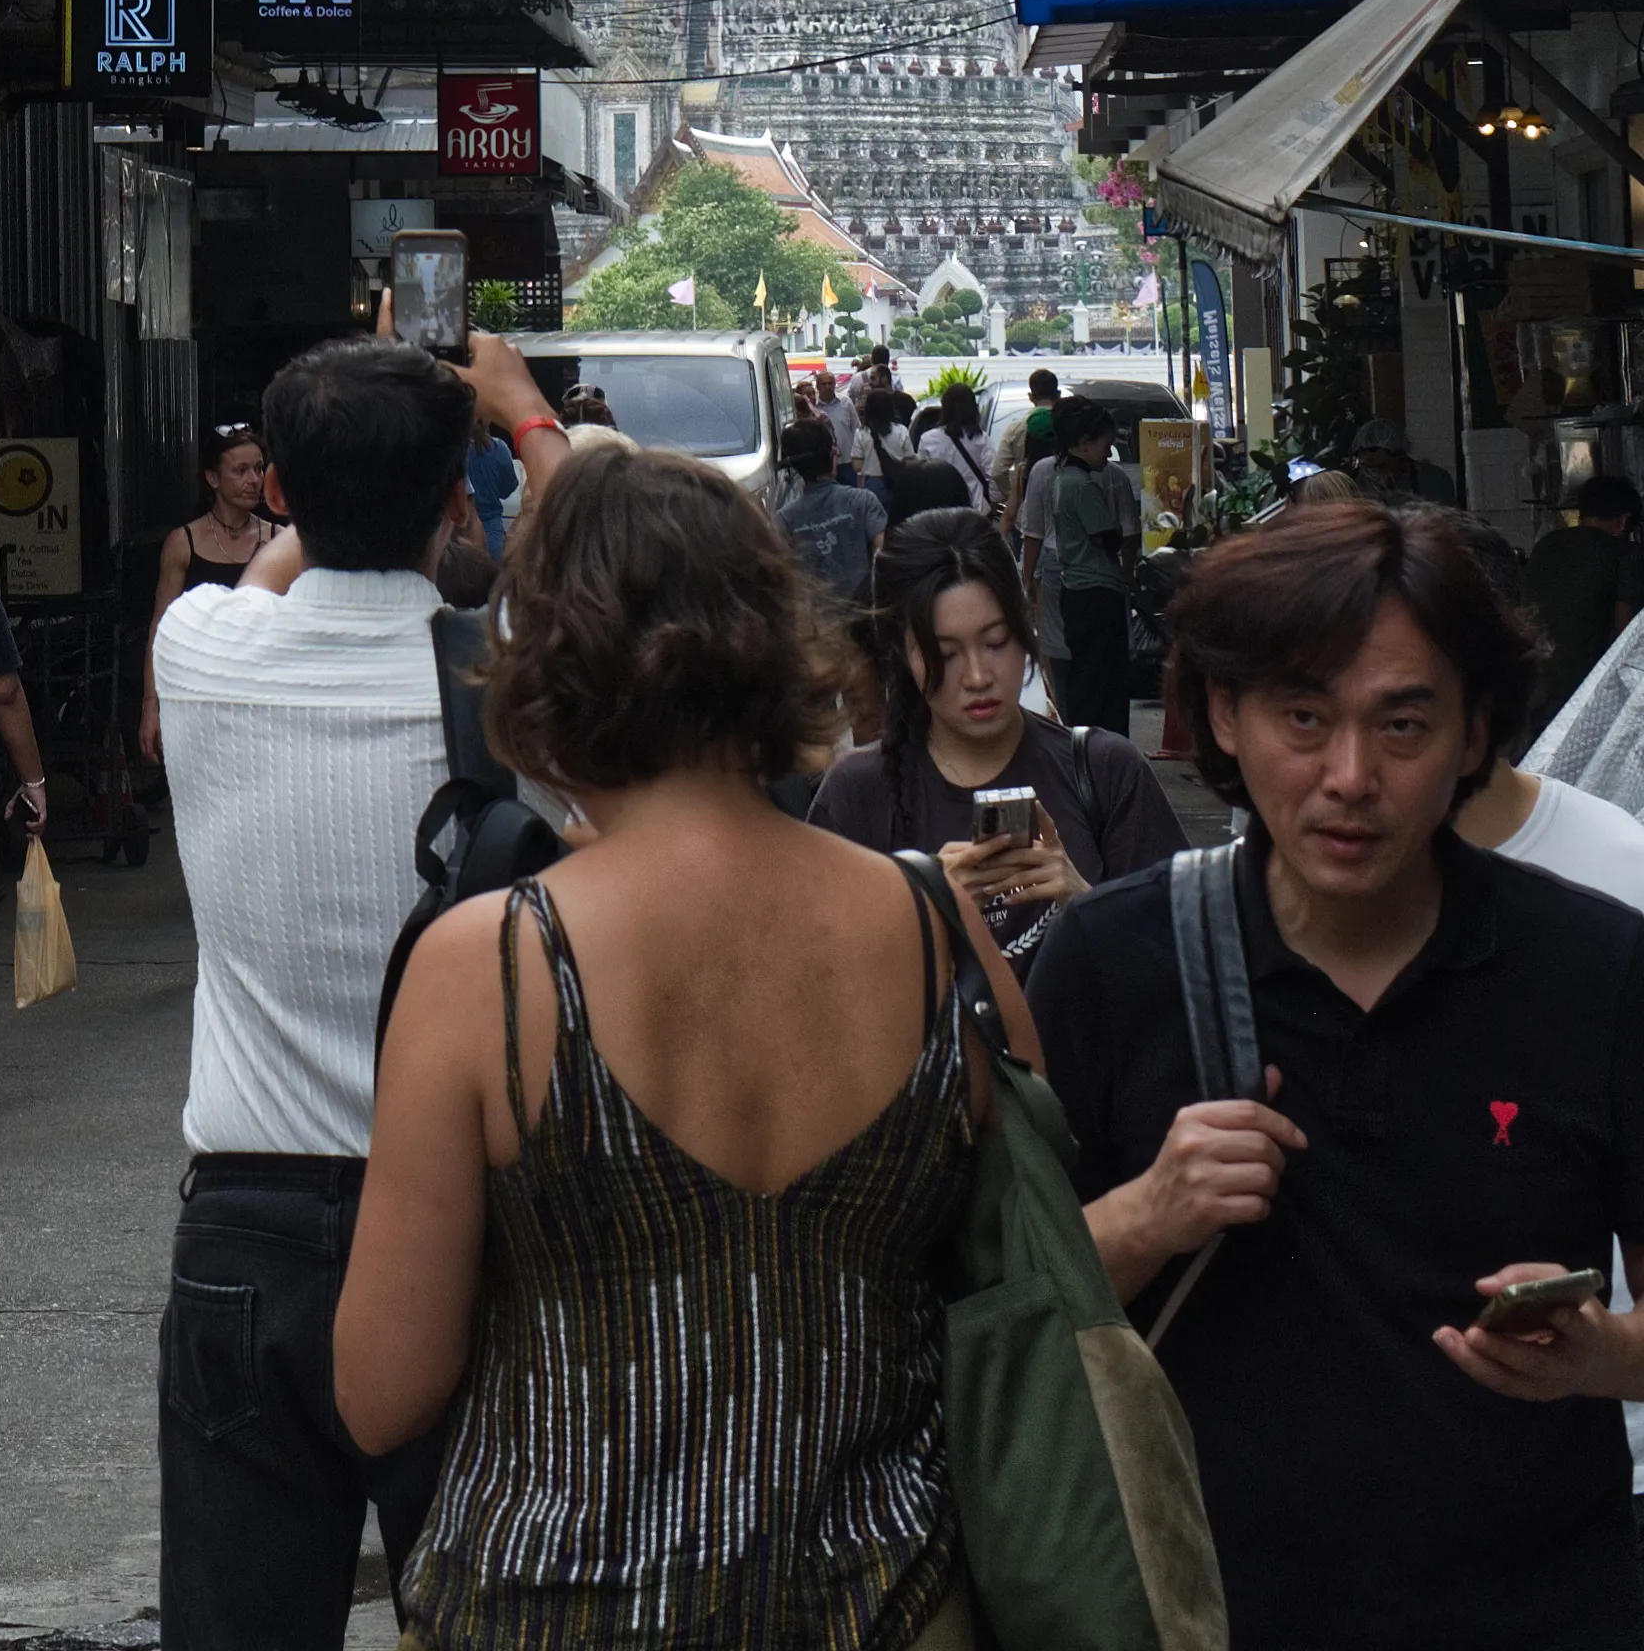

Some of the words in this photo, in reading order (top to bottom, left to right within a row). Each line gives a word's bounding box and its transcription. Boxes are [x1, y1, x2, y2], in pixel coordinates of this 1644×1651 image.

[258, 5, 300, 18] Coffee
[303, 5, 313, 18] &
[316, 5, 352, 18] Dolce
[97, 51, 187, 73] RALPH
[110, 74, 172, 86] Bangkok
[446, 126, 532, 160] AROY
[464, 160, 515, 169] TATIEN
